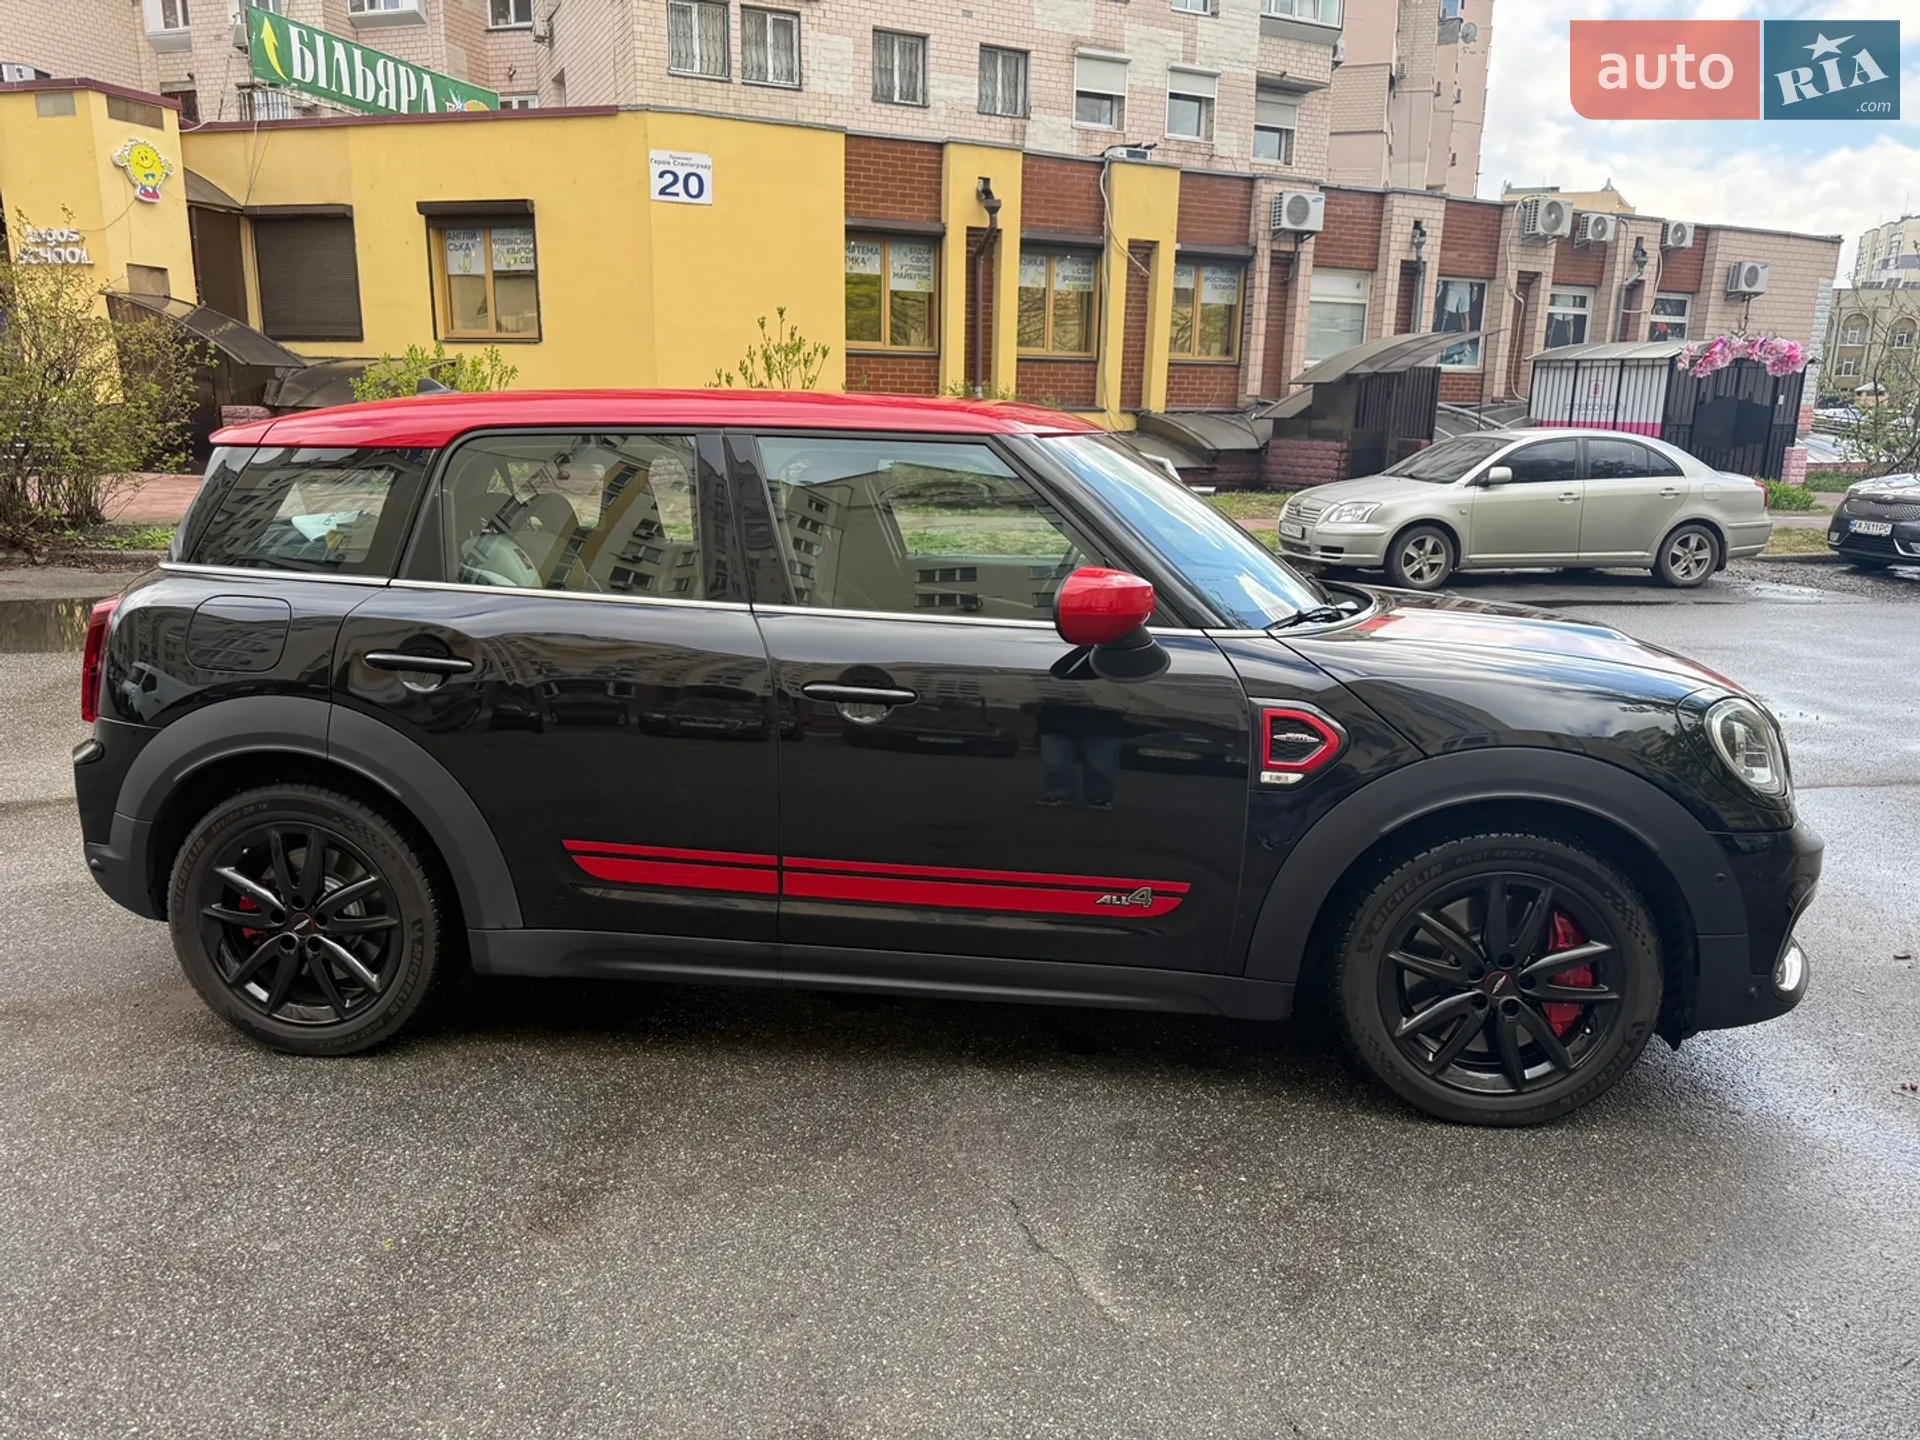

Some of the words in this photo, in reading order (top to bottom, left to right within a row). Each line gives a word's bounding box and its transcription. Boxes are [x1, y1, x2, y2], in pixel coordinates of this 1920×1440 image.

[658, 169, 704, 199] 20
[446, 231, 477, 240] АНГЛІЙ
[1095, 886, 1153, 908] ALL4
[1372, 862, 1442, 931] MICHELIN
[388, 942, 424, 1016] MICHELIN
